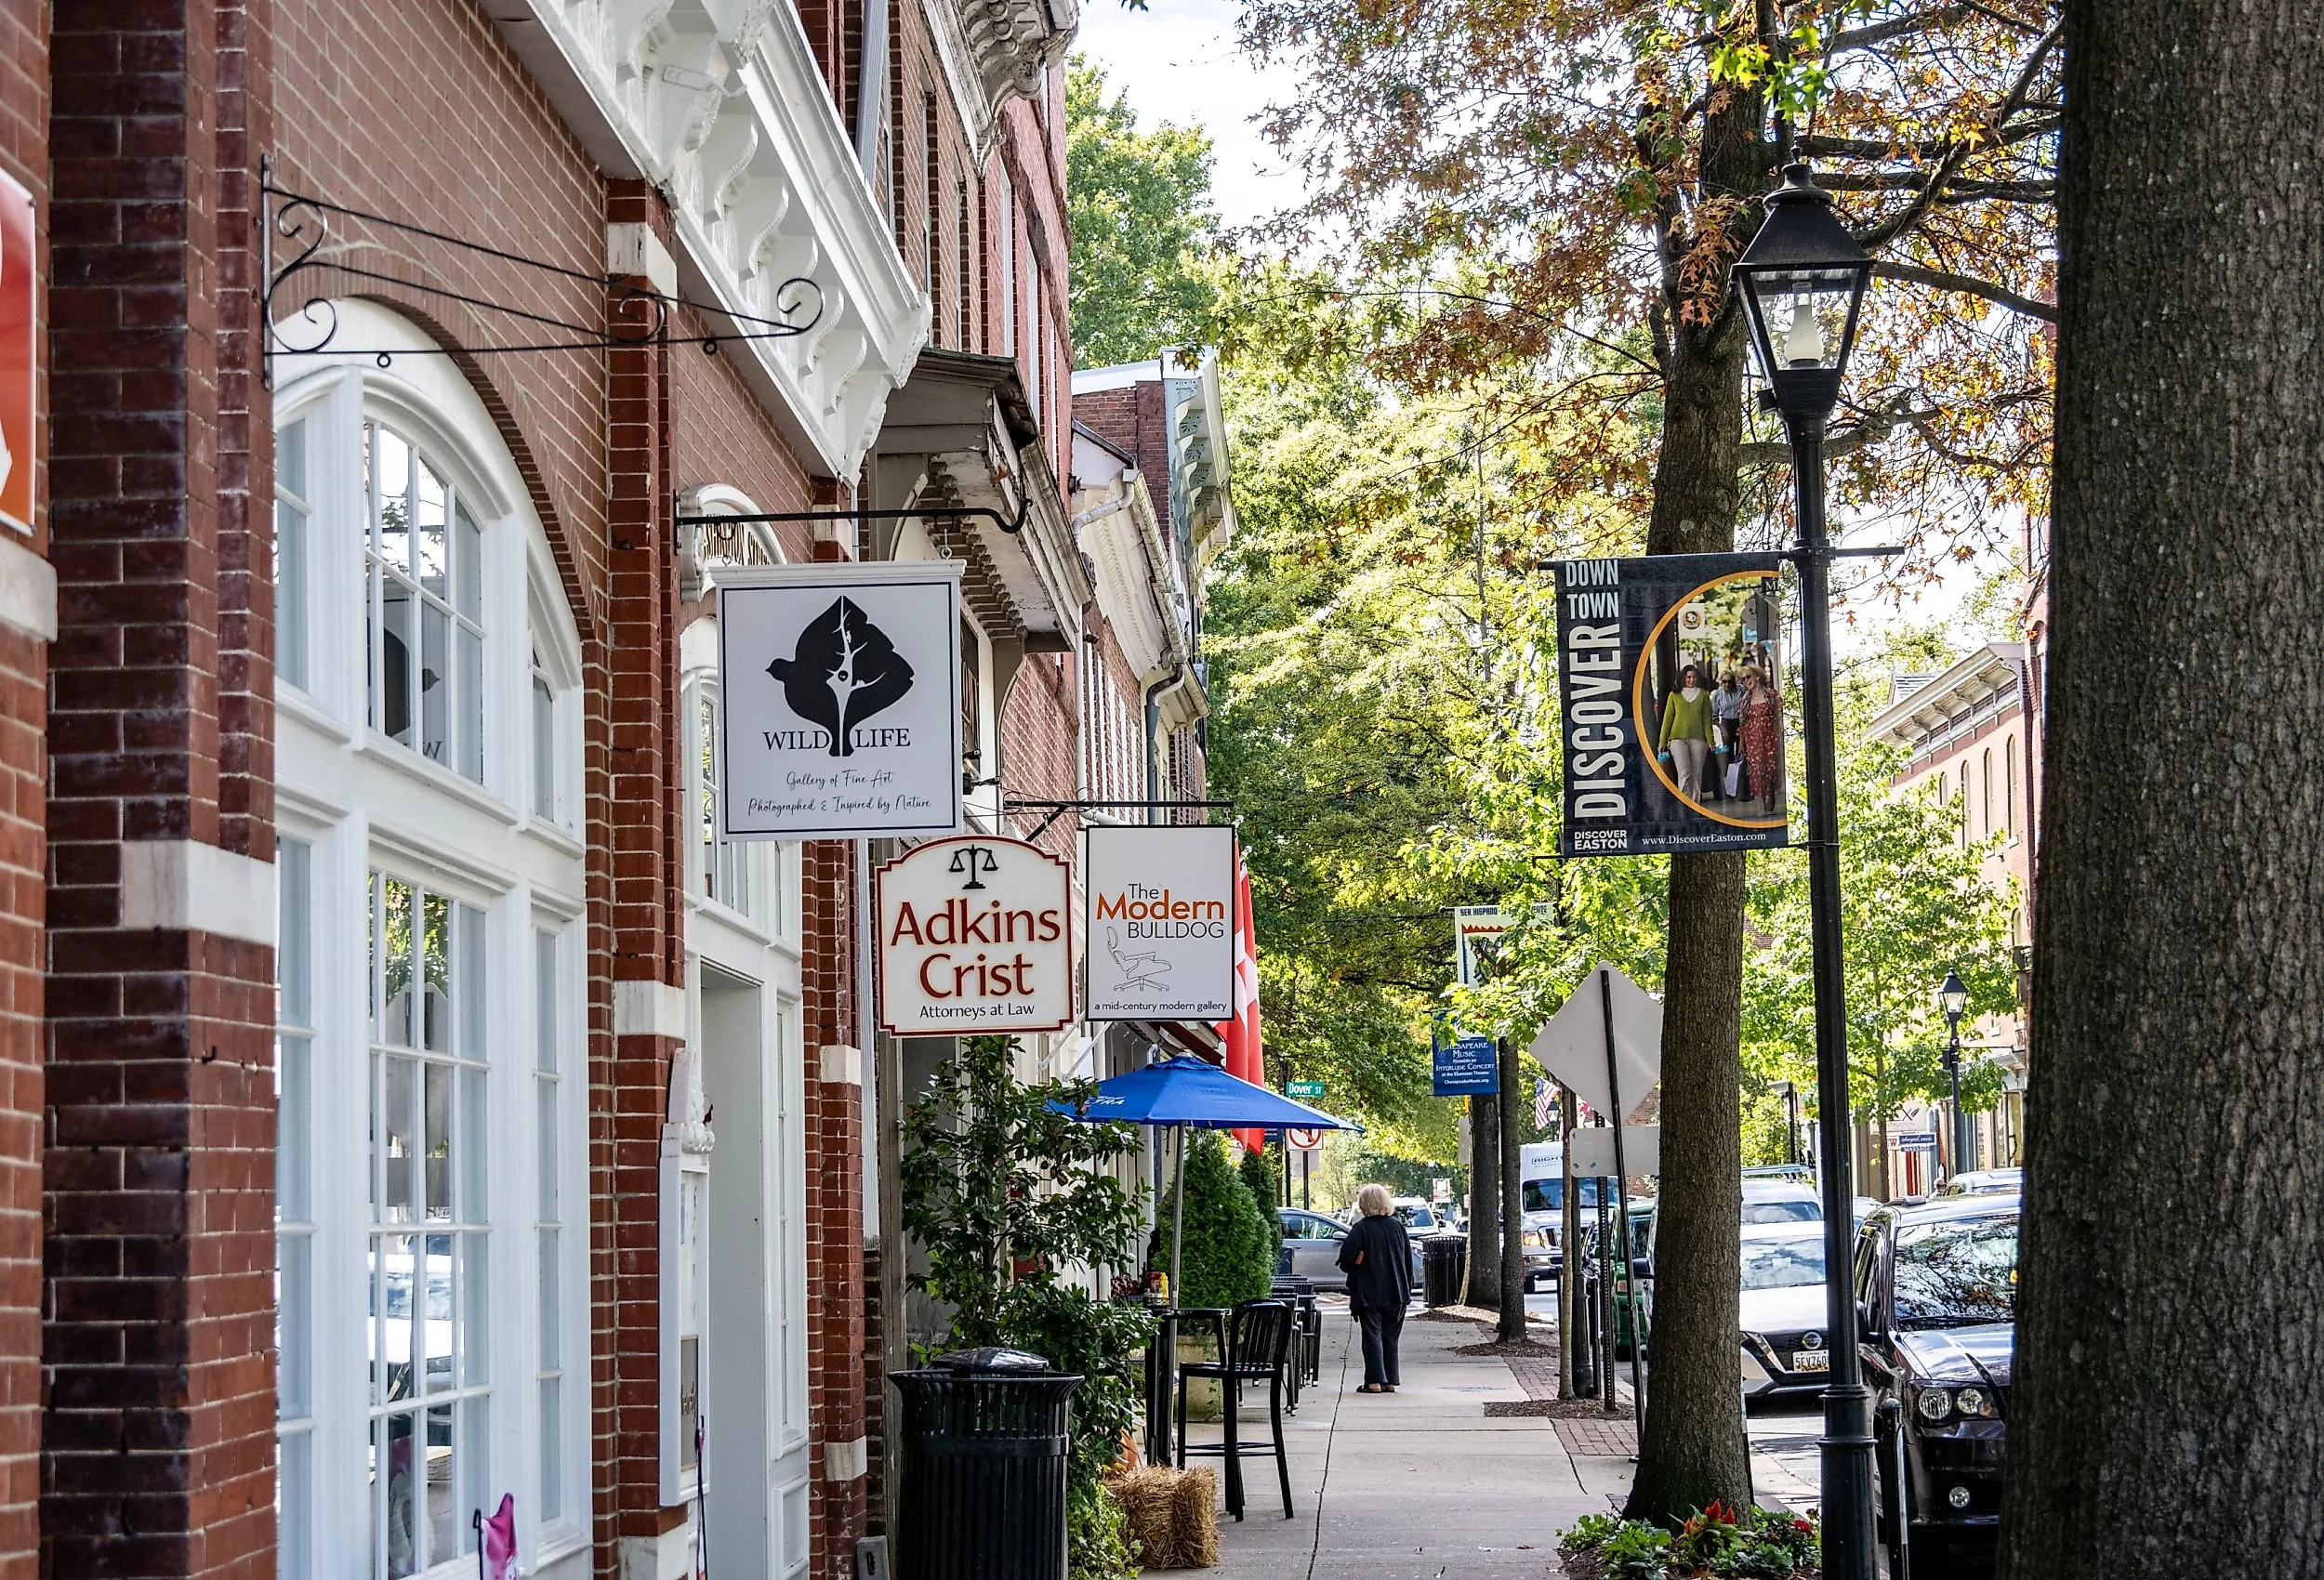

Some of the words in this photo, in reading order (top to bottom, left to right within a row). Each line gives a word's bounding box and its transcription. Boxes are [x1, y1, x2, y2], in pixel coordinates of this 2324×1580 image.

[1565, 560, 1619, 587] DOWN
[1566, 591, 1619, 620] TOWN
[1568, 623, 1627, 819] DISCOVER
[762, 730, 830, 750] WILD
[854, 728, 911, 748] LIFE
[786, 770, 826, 791] Gallery
[829, 773, 839, 788] of
[841, 770, 868, 787] Fine
[870, 770, 896, 788] Art
[747, 797, 816, 818] Photographed
[832, 795, 874, 814] Inspired
[877, 797, 891, 814] by
[895, 794, 931, 810] Nature
[1574, 829, 1627, 840] DISCOVER
[1642, 833, 1766, 846] www.DiscoverEaston.com
[1574, 838, 1628, 850] EASTON
[1128, 883, 1159, 900] The
[1096, 889, 1225, 920] Modern
[1459, 908, 1472, 916] SER
[1472, 906, 1499, 916] HISPANO
[890, 898, 1062, 947] Adkins
[1128, 921, 1224, 939] BULLDOG
[919, 953, 1035, 999] Crist
[919, 1005, 986, 1020] Attorneys
[990, 1004, 1004, 1016] at
[1008, 1003, 1036, 1016] Law
[1102, 1001, 1157, 1012] mid-century
[1159, 1001, 1195, 1010] modern
[1196, 1000, 1227, 1013] gallery
[1446, 1042, 1488, 1050] HESAPEAKE
[1288, 1083, 1314, 1094] Dover
